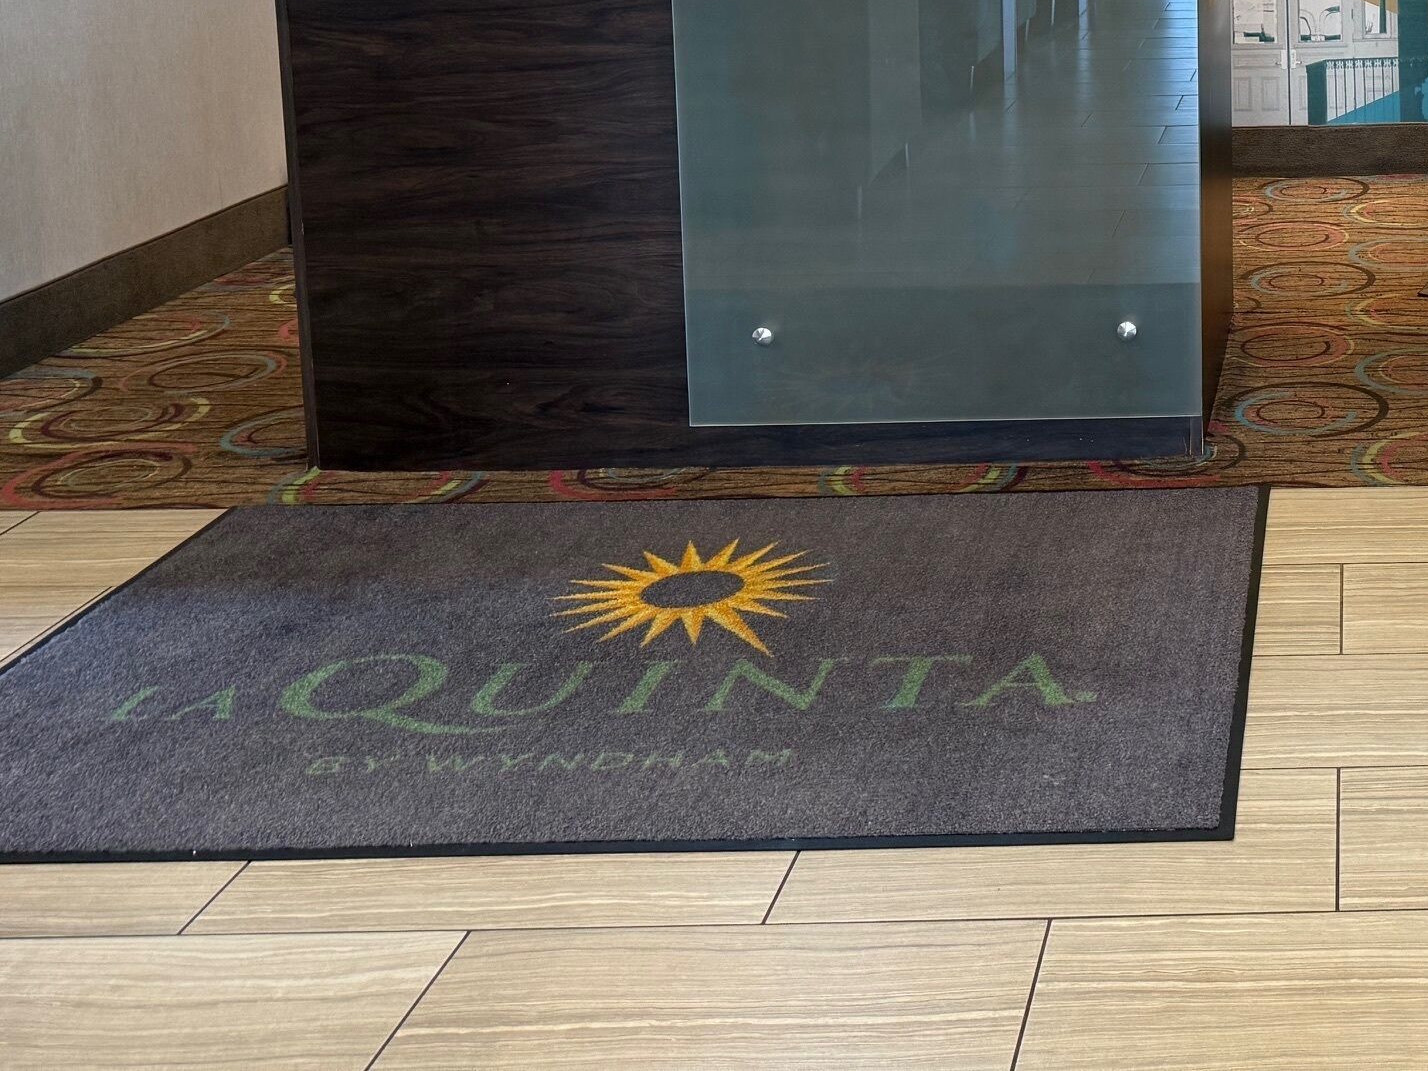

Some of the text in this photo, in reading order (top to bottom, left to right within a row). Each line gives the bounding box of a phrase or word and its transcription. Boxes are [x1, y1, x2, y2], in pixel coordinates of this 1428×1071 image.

[112, 651, 1080, 735] LA QUINTA
[305, 747, 794, 776] BY WYNDHAM
